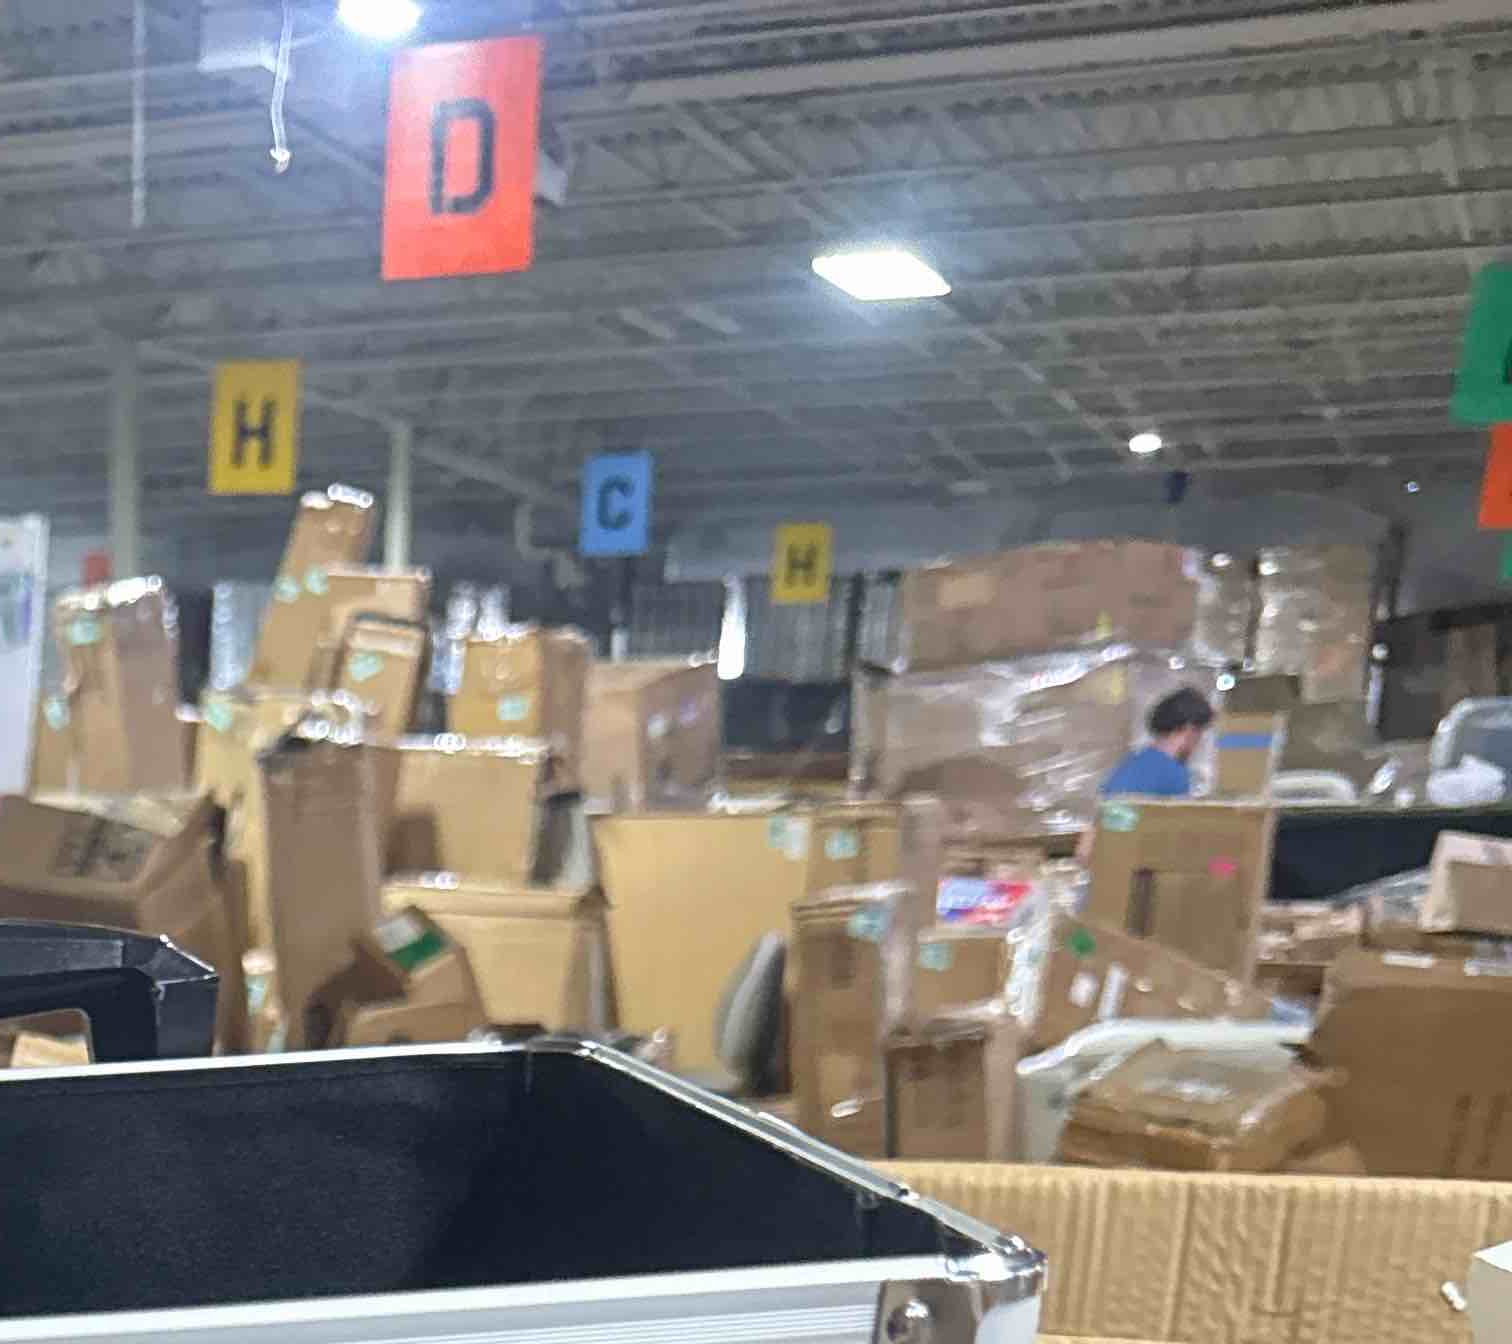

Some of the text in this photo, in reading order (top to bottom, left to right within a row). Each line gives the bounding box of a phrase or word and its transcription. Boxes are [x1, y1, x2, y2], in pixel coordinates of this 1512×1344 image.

[428, 98, 496, 216] D
[231, 393, 278, 471] H
[597, 476, 634, 530] C
